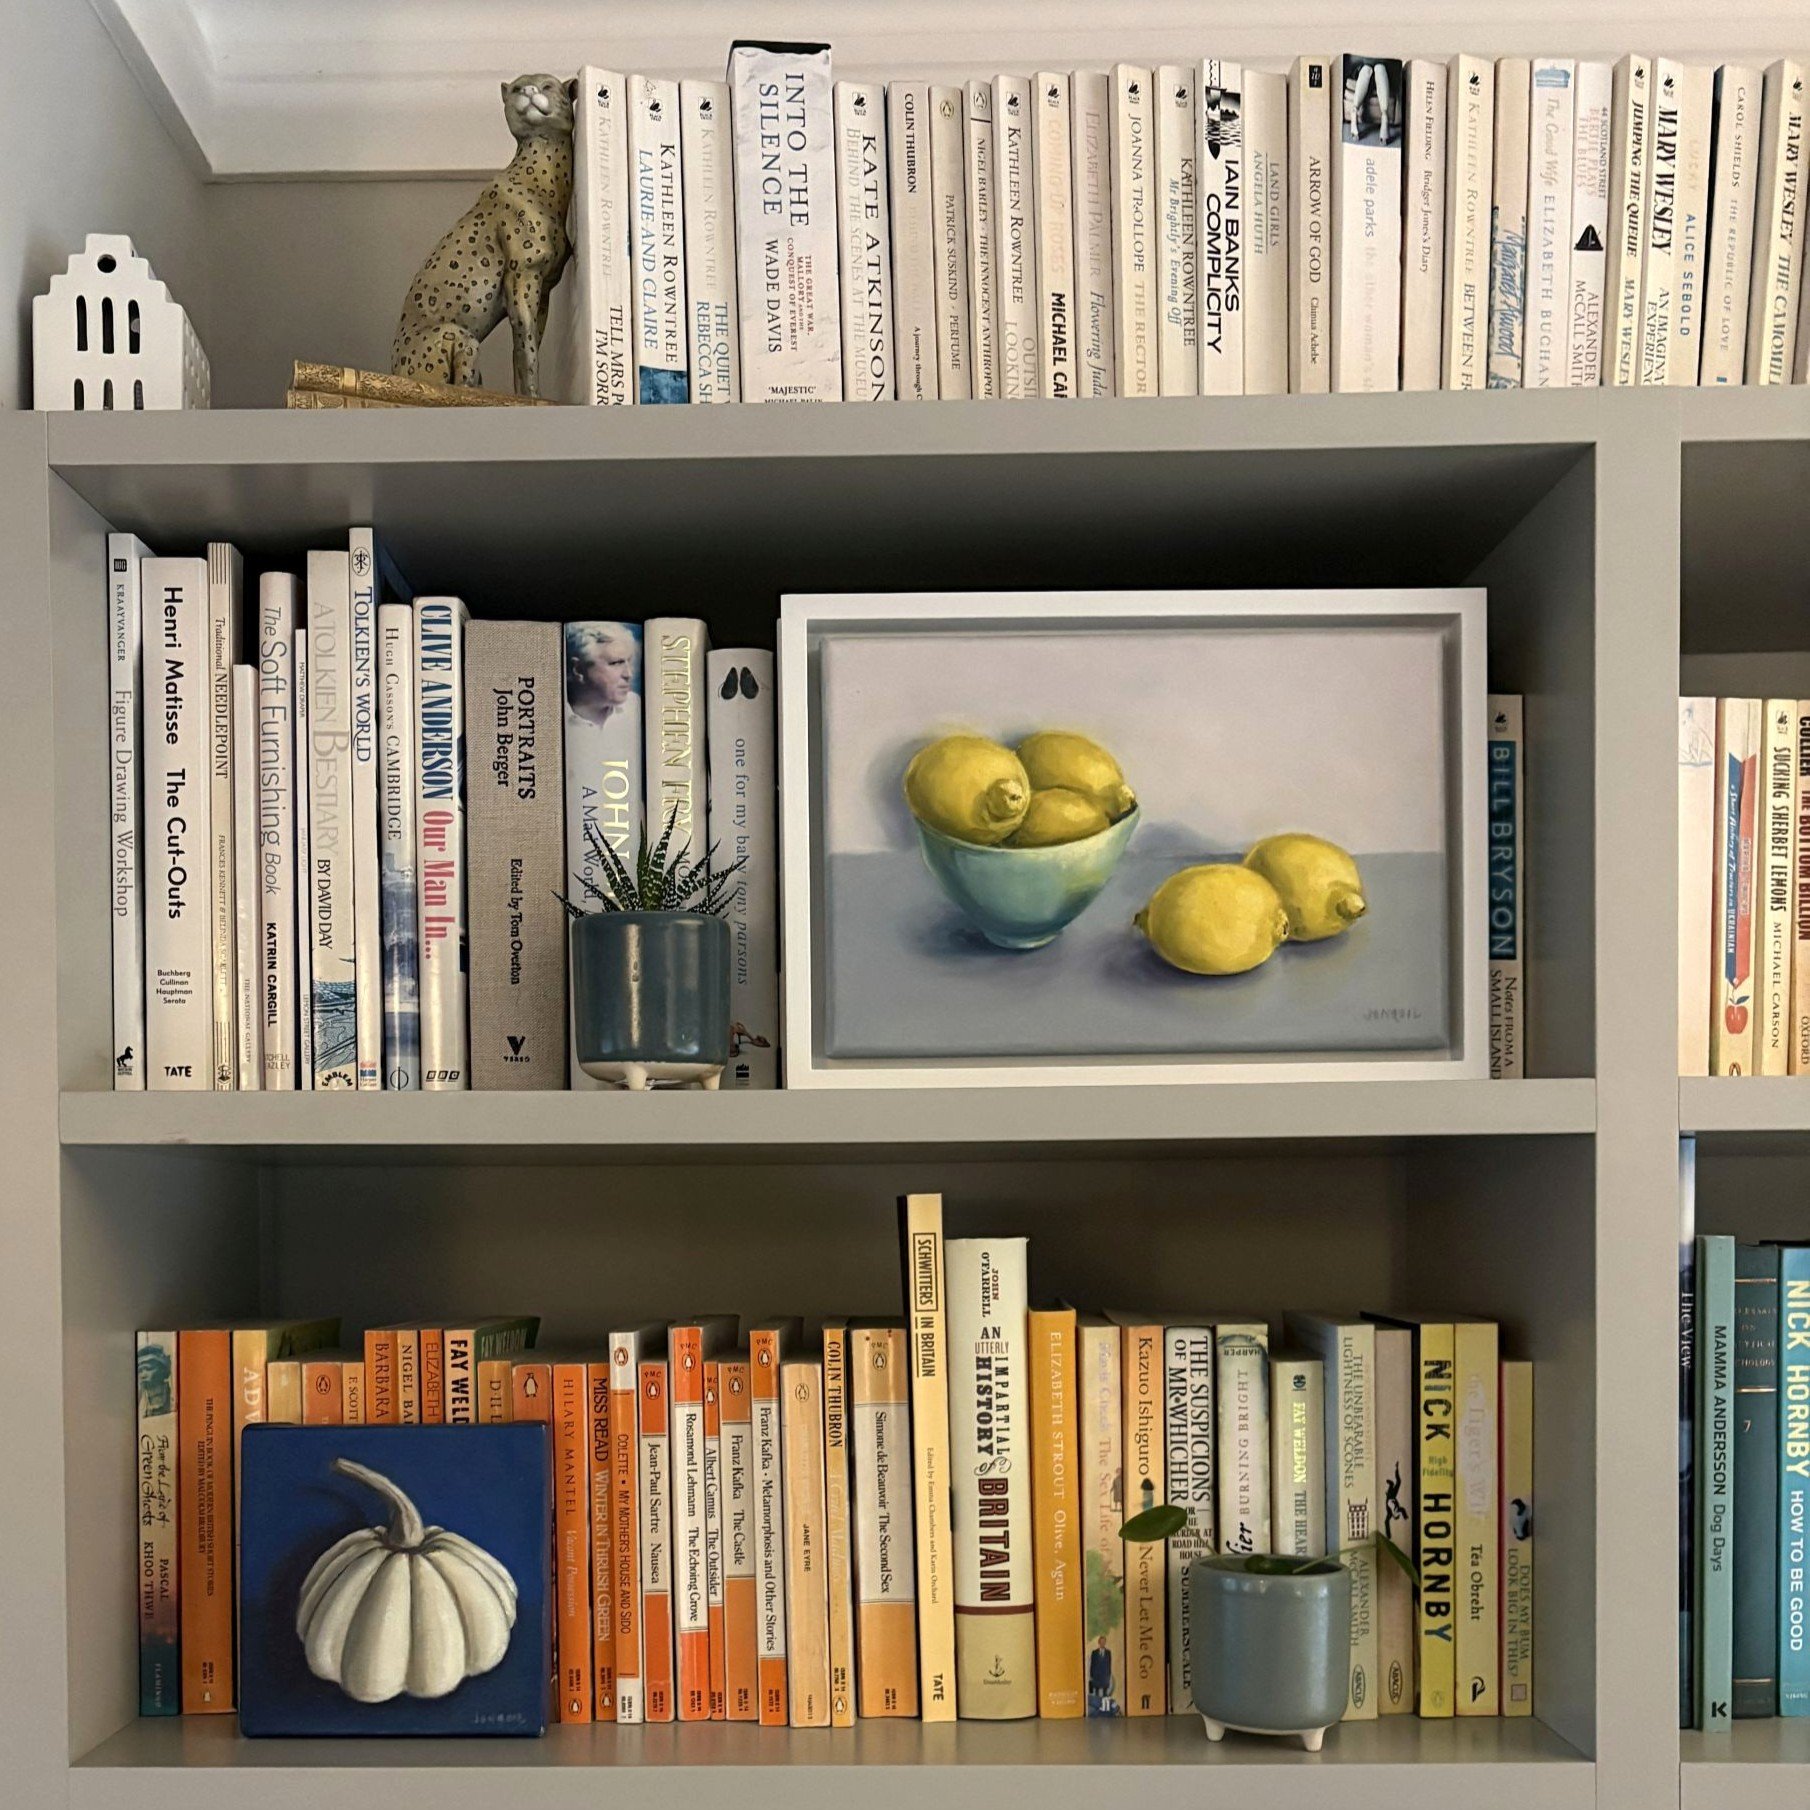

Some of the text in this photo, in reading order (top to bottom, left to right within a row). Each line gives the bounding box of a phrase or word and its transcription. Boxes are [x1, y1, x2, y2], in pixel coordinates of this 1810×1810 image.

[759, 83, 782, 216] SILENCE
[785, 73, 809, 228] INTO THE
[904, 93, 915, 131] COLIN
[906, 133, 917, 193] THUBRON
[1420, 81, 1435, 273] HELEN FIELDING Bridget Jones's Diary
[1626, 100, 1644, 257] JUMPING THE QUEUE
[1651, 105, 1677, 257] MARY WESLEY
[639, 149, 658, 349] LAURIE AND CLAIRE
[661, 144, 678, 363] KATHLEEN ROWNTREE
[1007, 127, 1024, 303] KATHLEEN ROWNTREE
[1167, 178, 1181, 327] Mr Brightly's Evening Off
[1181, 157, 1195, 346] KATHLEEN ROWNTREE
[1225, 160, 1239, 311] IAIN BANKS
[1254, 150, 1263, 254] ANGELA HUTH
[1270, 162, 1279, 247] LAND GIRLS
[1309, 156, 1321, 364] ARROW OF GOD Chinua Achebe
[1364, 158, 1377, 237] adele parks
[765, 239, 782, 353] WADE DAVIS
[787, 237, 798, 352] CONQUEST OF EVEREST
[862, 135, 885, 401] KATE ATKINSON
[945, 194, 960, 370] PATRICK SUSKIND PERFUME
[1207, 193, 1221, 354] COMPLICITY
[1680, 213, 1696, 336] ALICE SEBOLD
[214, 617, 228, 779] Traditional NEEDLEPOINT
[353, 587, 372, 763] TOLKIEN'S WORLD
[421, 605, 452, 671] CLIVE
[112, 584, 133, 917] KRAAYVANGER Figure Drawing Workshop
[164, 587, 187, 919] Henri Matisse The Cut-Outs
[386, 628, 402, 840] HUGH CASSON'S CAMBRIDGE
[421, 679, 453, 801] ANDERSON
[493, 689, 513, 787] John Berger
[518, 677, 535, 799] PORTRAITS
[733, 738, 748, 828] one for my
[260, 607, 287, 1027] The Soft Furnishing Book KATRIN CARGILL
[423, 811, 454, 851] Our
[423, 860, 455, 907] Man
[1491, 747, 1513, 955] BILL BRYSON
[318, 859, 332, 949] BY DAVID DAY
[508, 859, 522, 985] Edited by Tom Overton
[1770, 746, 1790, 1049] SUCKING SHERBET LEMONS MICHAEL CARSON
[164, 1067, 192, 1077] TATE
[918, 1239, 936, 1377] SCHWITTERS IN BRITAIN
[981, 1252, 991, 1318] O'FARRELL
[981, 1327, 1001, 1340] AN
[991, 1268, 999, 1300] JOHN
[976, 1356, 993, 1456] HISTORY
[994, 1356, 1010, 1456] IMPARTIAL
[1134, 1337, 1154, 1475] Kazuo Ishiguro
[1710, 1325, 1727, 1572] MAMMA ANDERSSON Dog Days
[1786, 1279, 1810, 1651] NICK HORNBY HOW TO BE GOOD
[648, 1443, 661, 1584] Jean-Paul Sartre Nausea
[706, 1447, 720, 1597] Albert Camus The Outsider
[759, 1407, 777, 1651] Franz Kafka Metamorphosis and Other Stories
[875, 1411, 891, 1593] Simone de Beauvoir The Second Sex
[978, 1478, 1010, 1602] BRITAIN
[1423, 1360, 1452, 1642] NICK HORNBY
[1138, 1546, 1153, 1679] Never Let Me Go
[1470, 1545, 1483, 1621] Téa Obreht
[932, 1674, 944, 1701] TATE
